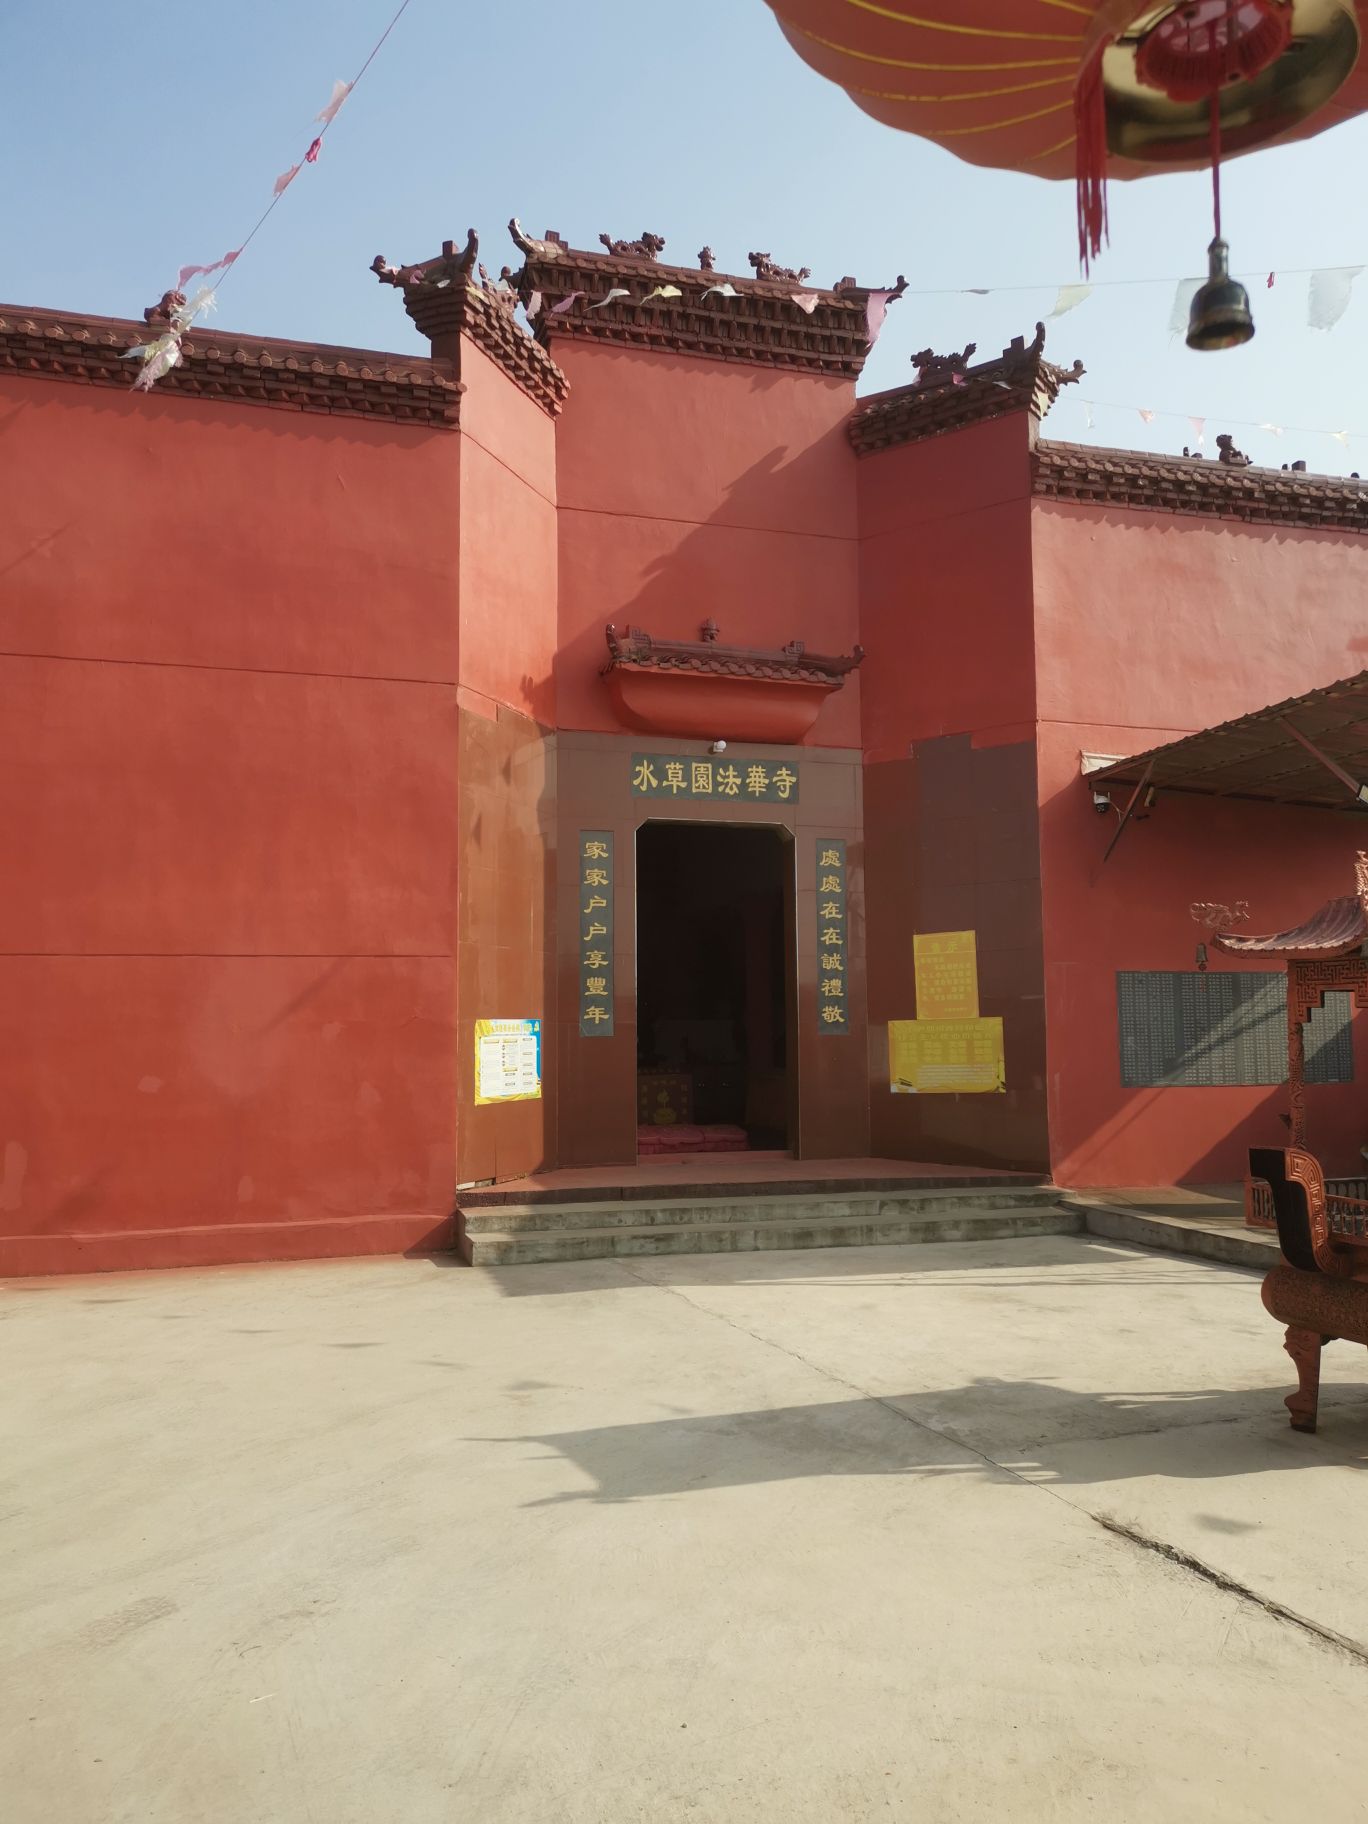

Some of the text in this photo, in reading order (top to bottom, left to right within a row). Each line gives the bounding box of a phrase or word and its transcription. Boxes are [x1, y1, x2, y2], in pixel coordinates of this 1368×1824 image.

[632, 759, 797, 798] 水草園法華寺
[819, 849, 846, 1023] 處處在在誠禮敬
